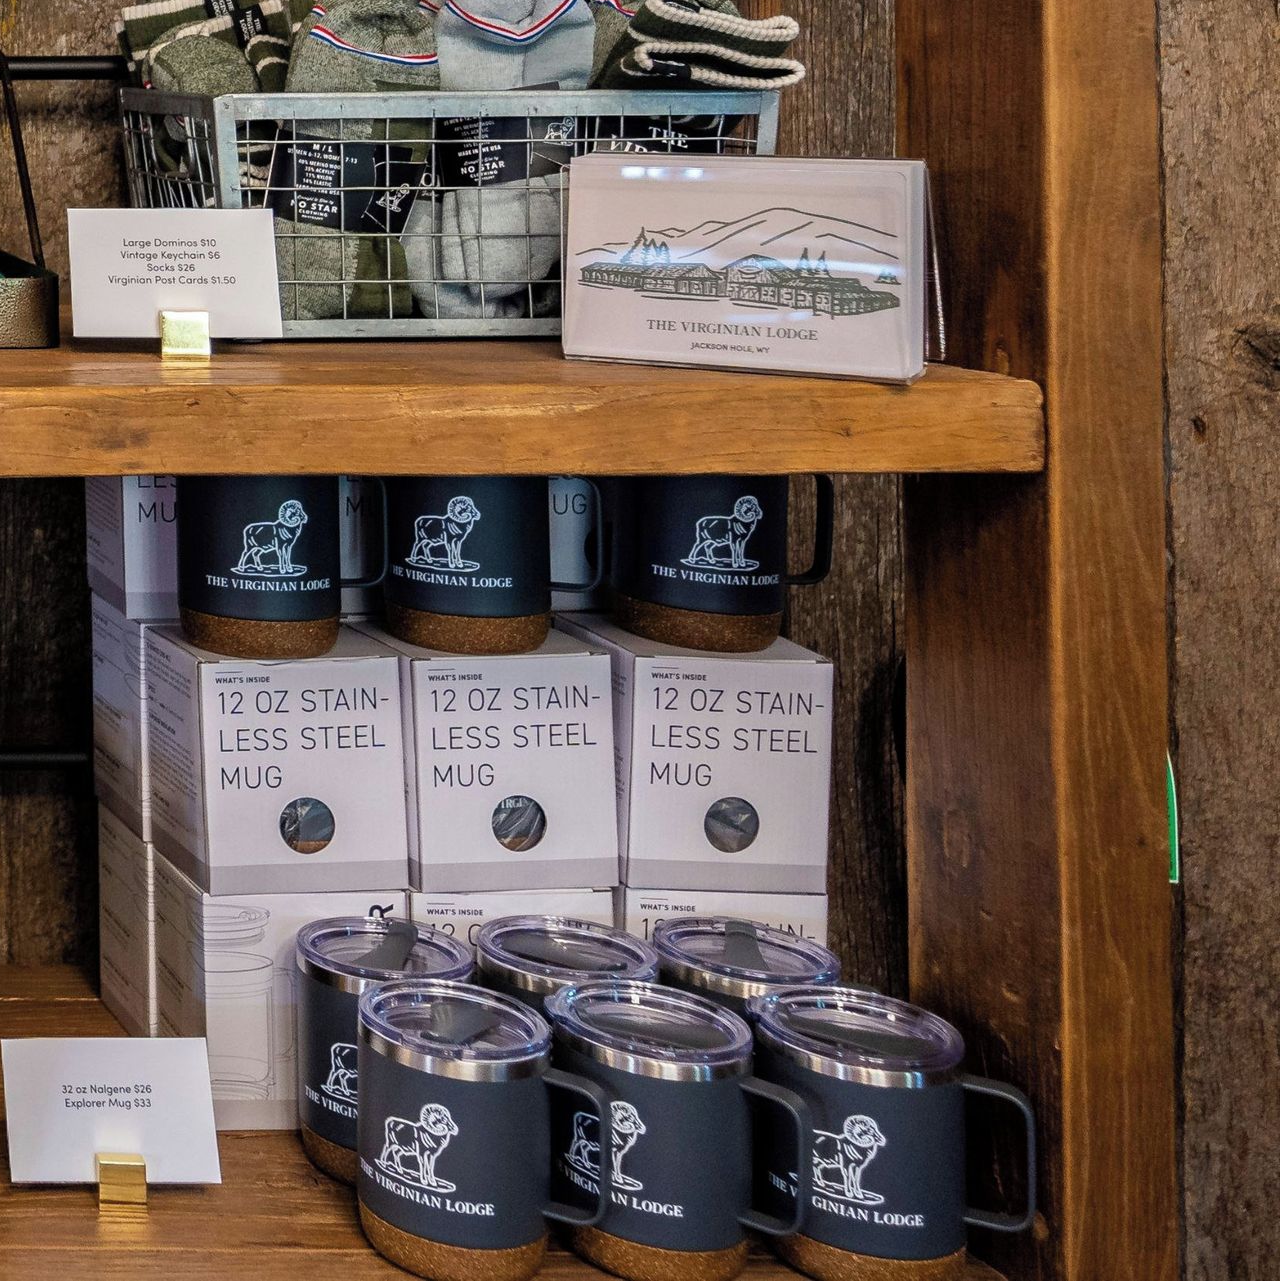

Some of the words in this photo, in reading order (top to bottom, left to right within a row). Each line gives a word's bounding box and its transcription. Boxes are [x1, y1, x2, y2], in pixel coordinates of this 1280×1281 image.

[123, 238, 151, 248] Large
[154, 239, 198, 247] Dominos
[200, 238, 217, 247] $10
[120, 251, 158, 261] Vintage
[161, 251, 205, 261] Keychain
[208, 251, 220, 259] $6
[147, 263, 175, 272] Socks
[178, 263, 195, 272] $26
[108, 276, 152, 286] Virginian
[155, 276, 176, 284] Post
[178, 276, 208, 285] Cards
[211, 276, 236, 285] $1.50
[646, 319, 677, 332] THE
[681, 321, 762, 338] VIRGINIAN
[767, 325, 818, 341] LODGE
[691, 341, 728, 351] JACKSON
[730, 344, 754, 354] HOLE,
[756, 346, 770, 354] WY
[206, 574, 229, 588] THE
[231, 579, 297, 592] VIRGINIAN
[300, 578, 331, 591] LODGE
[651, 672, 680, 680] WHAT'S
[218, 691, 244, 714] 12
[255, 690, 289, 713] OZ
[301, 687, 390, 713] STAIN-
[653, 687, 679, 710] 12
[690, 689, 724, 712] OZ
[736, 691, 825, 715] STAIN-
[220, 728, 288, 752] LESS
[301, 725, 386, 750] STEEL
[651, 724, 720, 749] LESS
[733, 728, 818, 753] STEEL
[221, 766, 282, 790] MUG
[650, 762, 712, 787] MUG
[61, 1084, 73, 1094] 32
[90, 1083, 132, 1099] Nalgene
[134, 1083, 152, 1095] $26
[65, 1098, 106, 1110] Explorer
[108, 1098, 131, 1110] Mug
[134, 1097, 152, 1108] $33
[360, 1157, 374, 1179] THE
[374, 1171, 441, 1209] VIRGINIAN
[445, 1199, 495, 1216] LODGE
